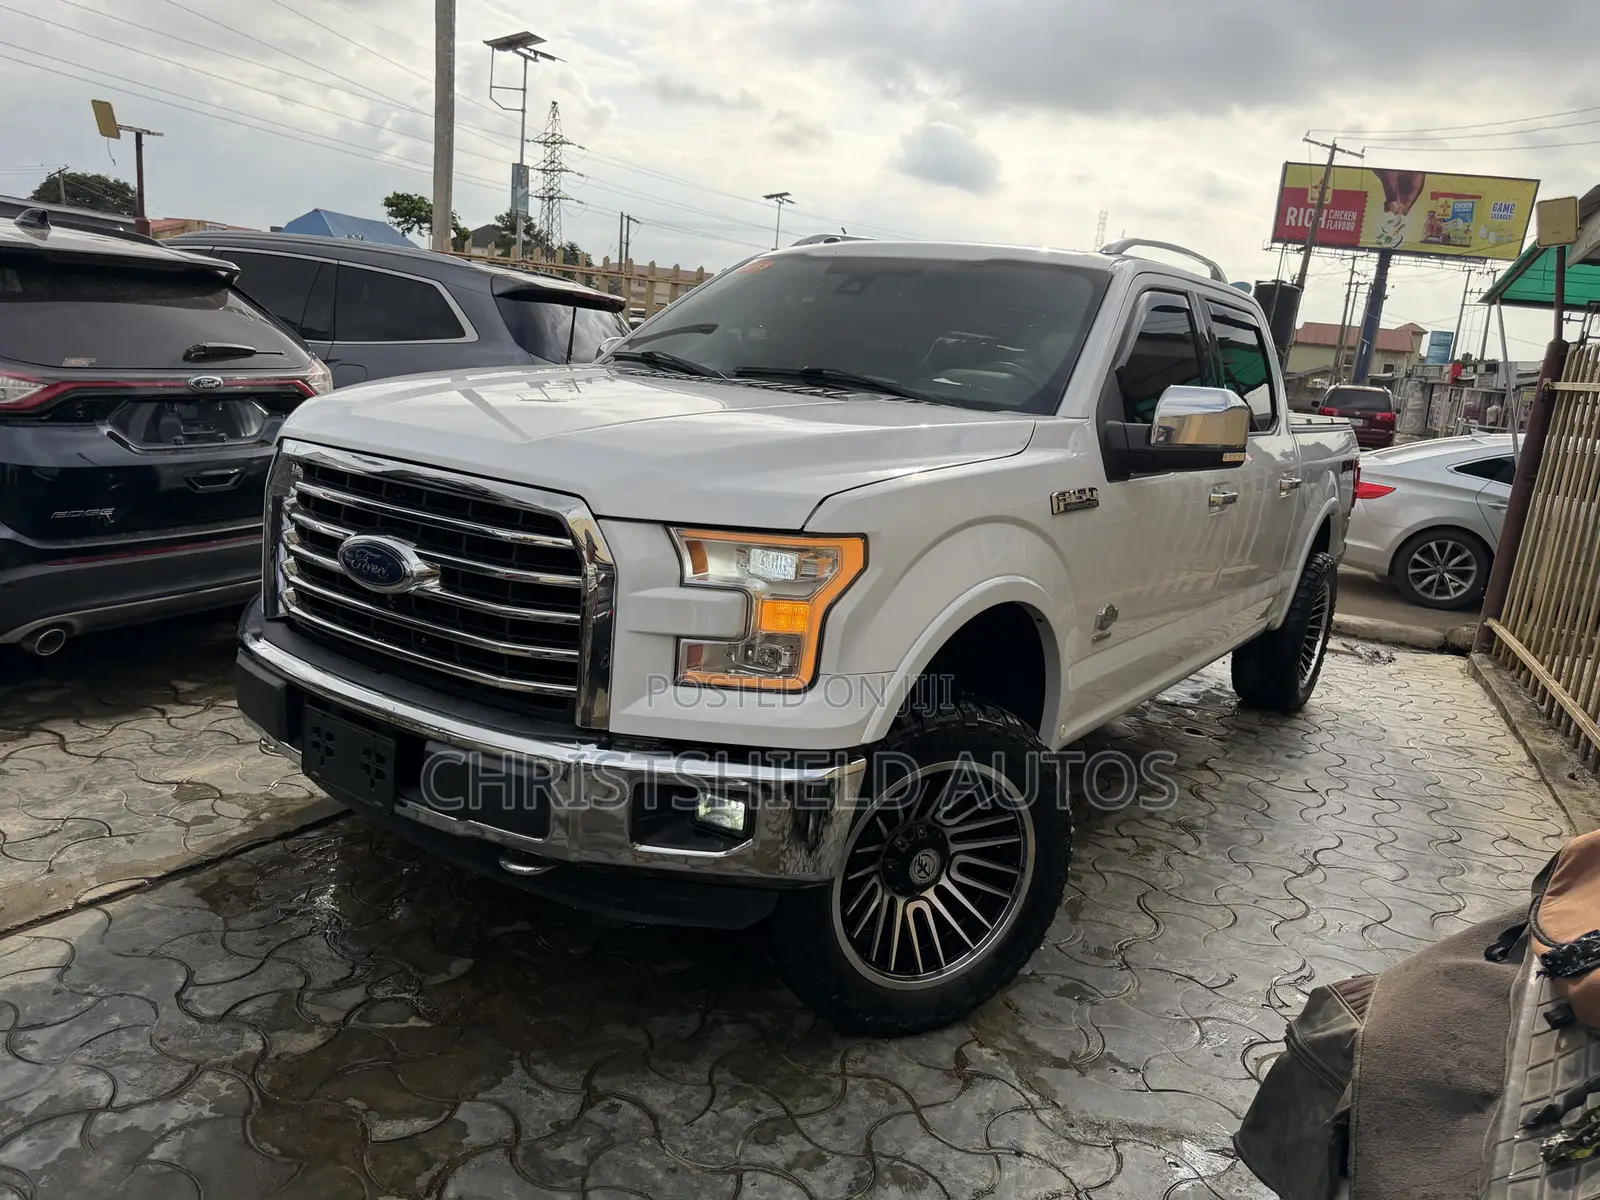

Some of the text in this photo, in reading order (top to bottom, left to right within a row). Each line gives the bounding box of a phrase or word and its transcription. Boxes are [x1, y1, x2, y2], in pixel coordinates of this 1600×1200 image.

[1492, 202, 1516, 214] GAME
[1285, 206, 1328, 229] RICH
[1328, 209, 1358, 222] CHICKEN
[1326, 219, 1356, 232] FLAVOUR
